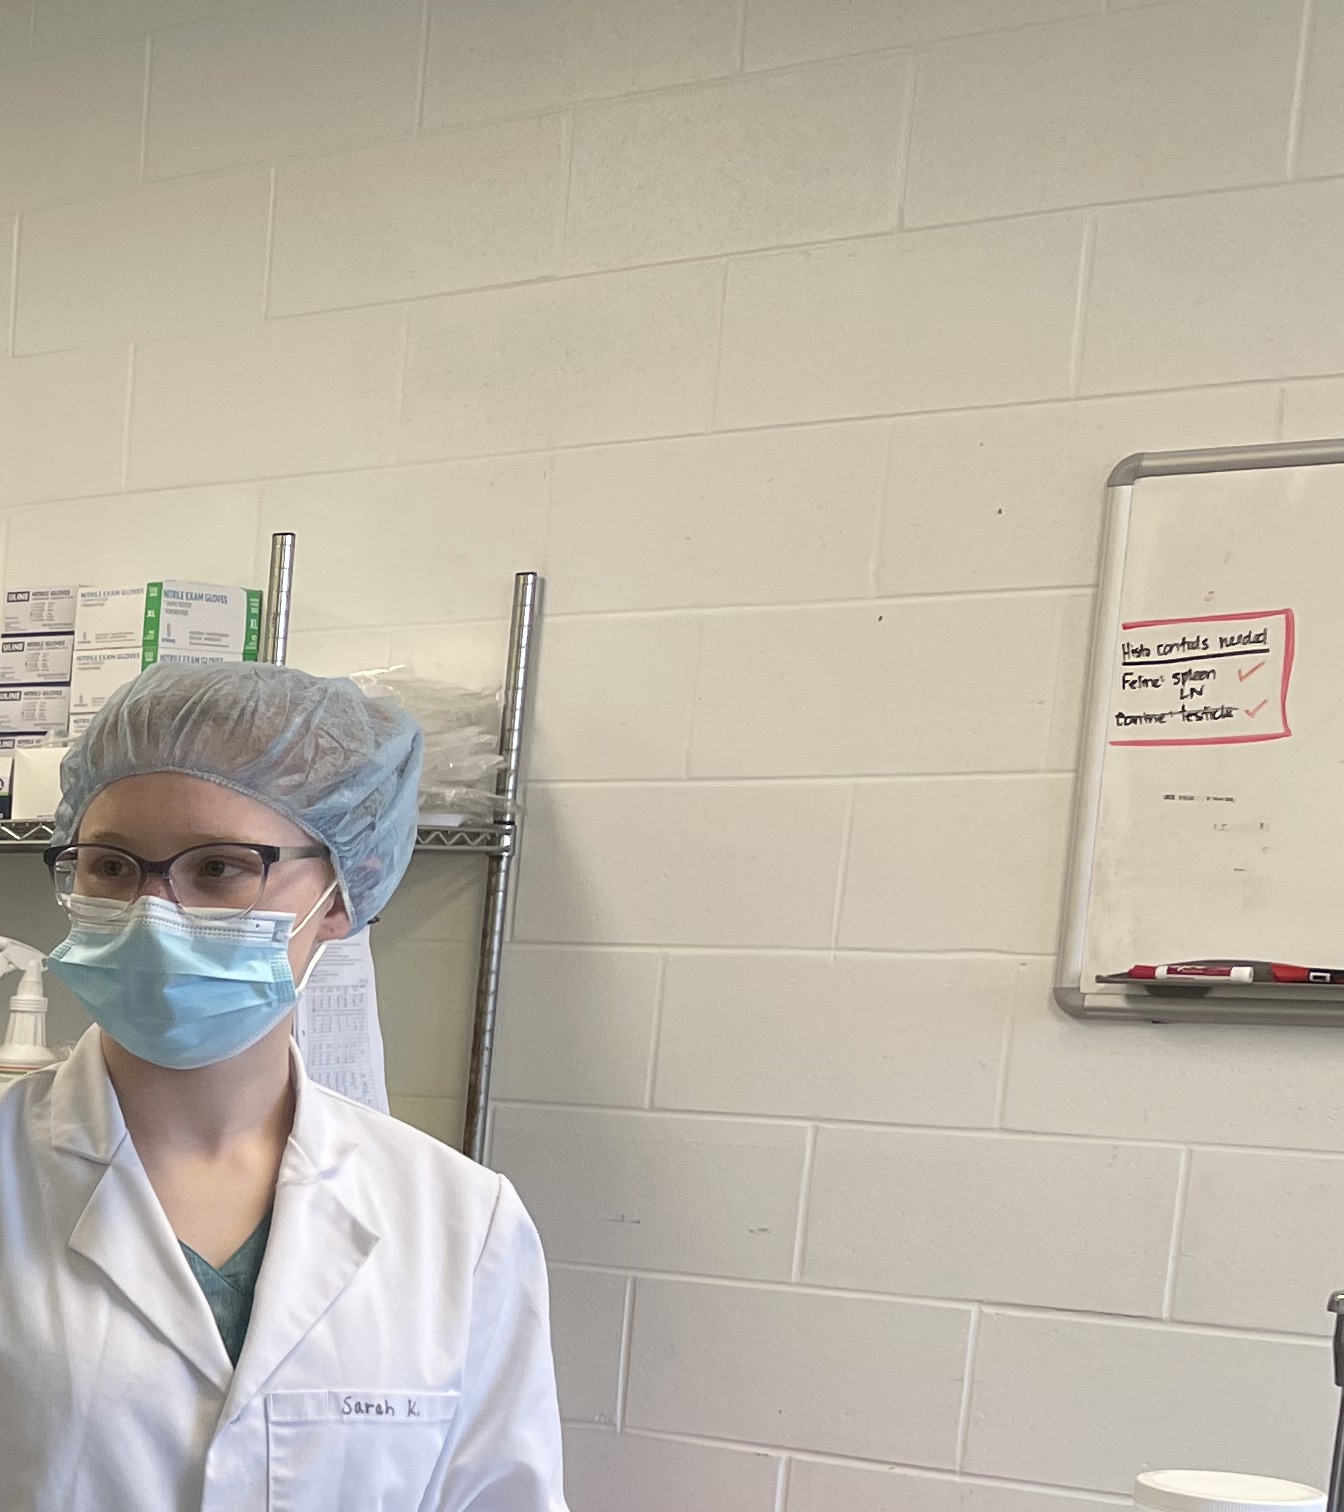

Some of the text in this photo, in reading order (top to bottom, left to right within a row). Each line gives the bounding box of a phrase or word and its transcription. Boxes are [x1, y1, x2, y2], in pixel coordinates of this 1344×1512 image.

[121, 588, 144, 596] GLOVES
[163, 589, 228, 604] NITRILE EXAM GLOVES
[1219, 628, 1268, 649] needed
[1180, 684, 1205, 700] LN
[342, 1396, 420, 1417] Sarah K.
